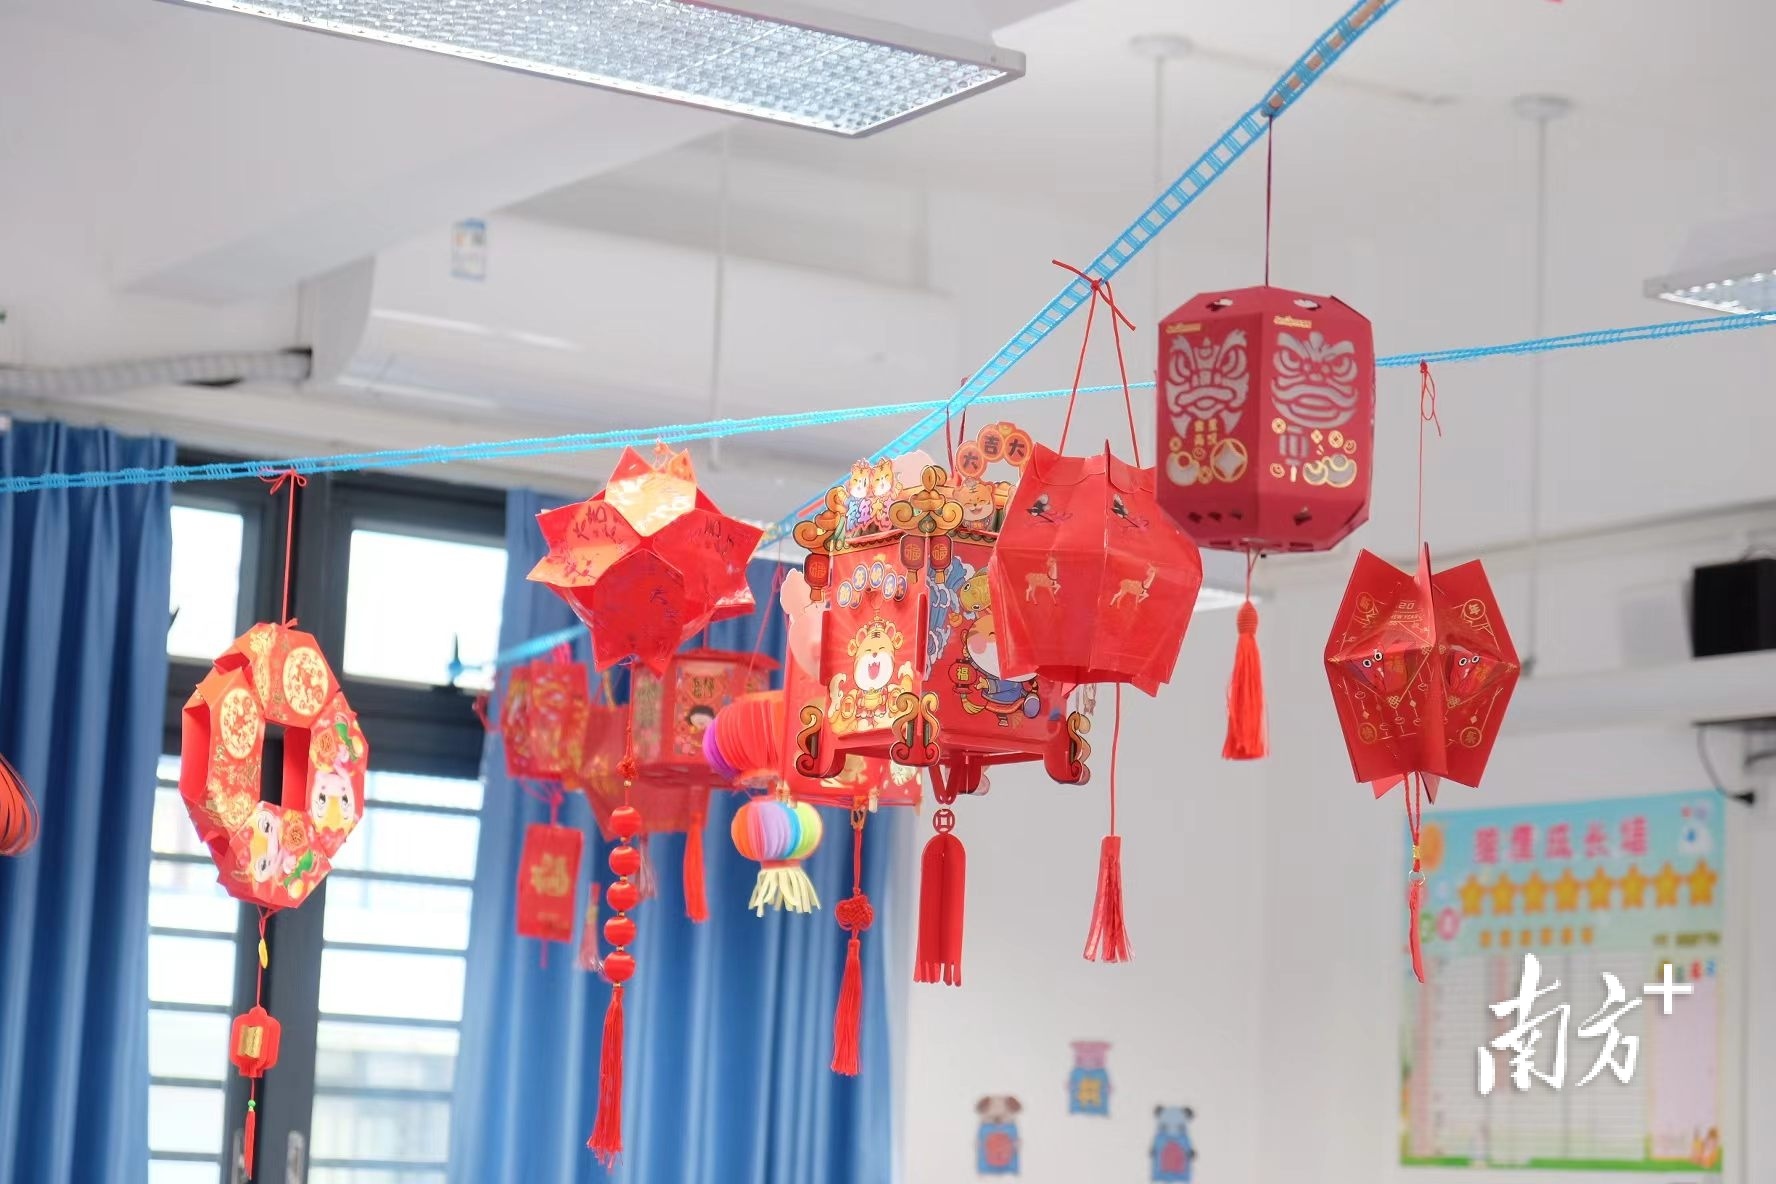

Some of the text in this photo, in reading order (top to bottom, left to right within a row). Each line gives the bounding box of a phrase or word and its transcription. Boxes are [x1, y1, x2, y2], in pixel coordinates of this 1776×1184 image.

[904, 544, 921, 561] 福
[932, 544, 948, 561] 福
[956, 665, 969, 681] 福
